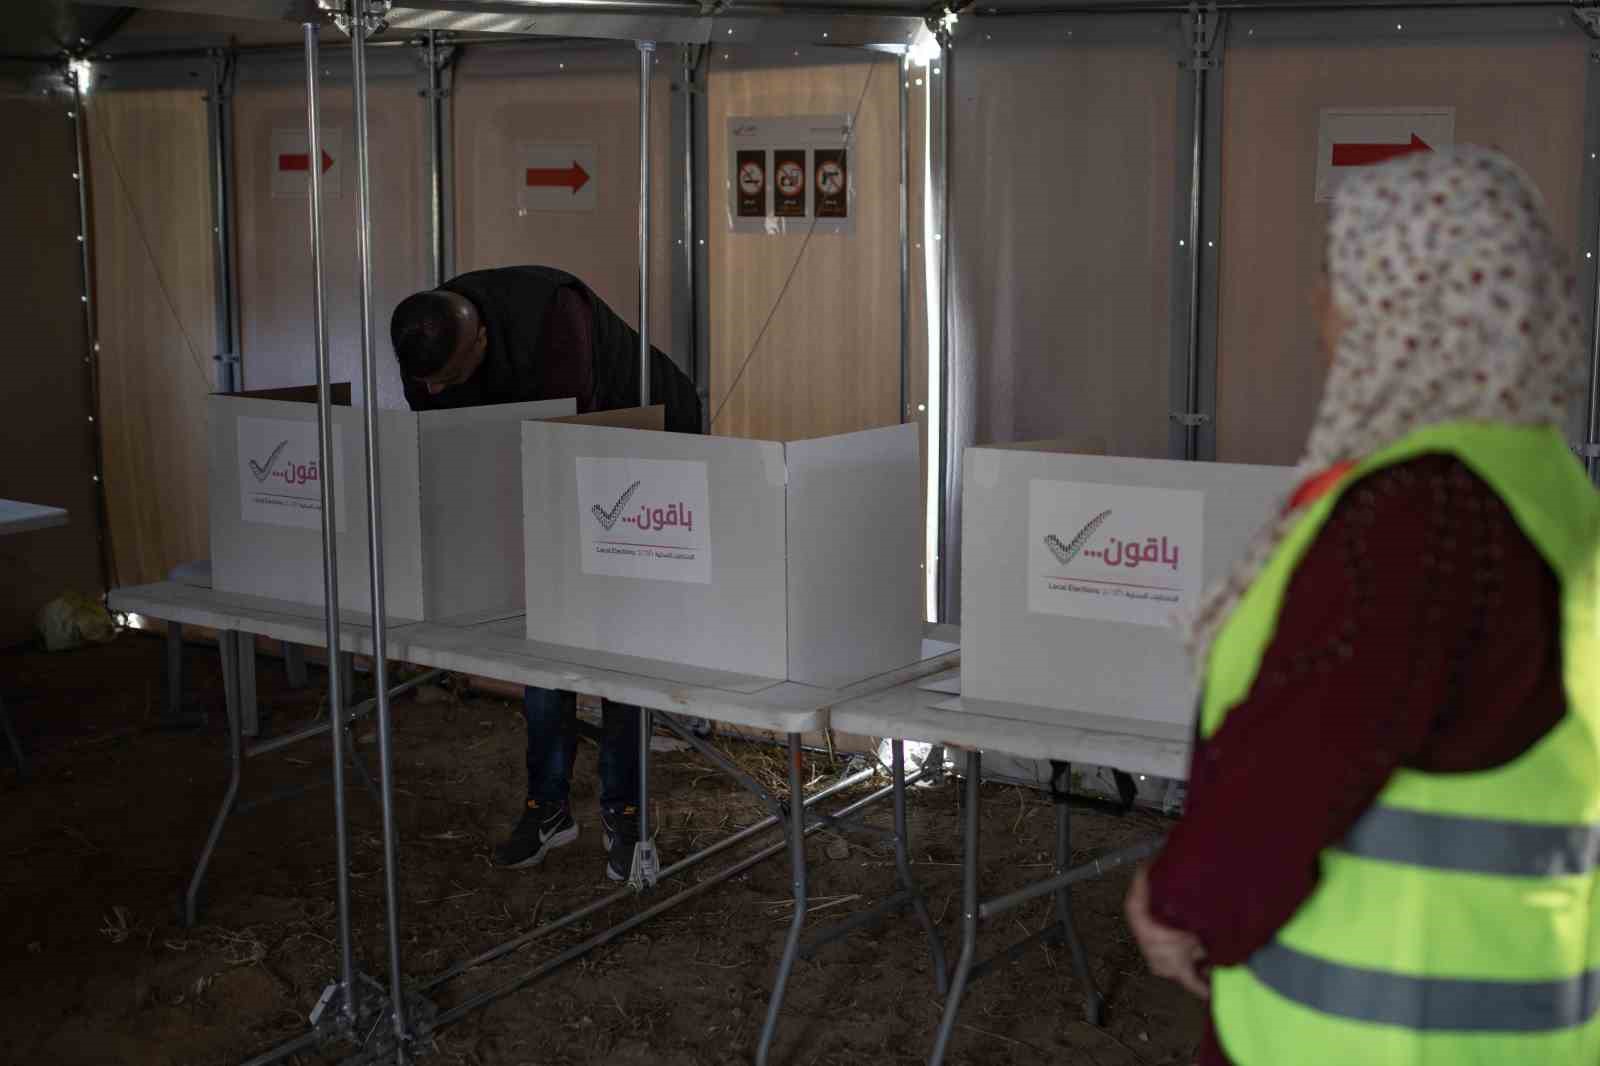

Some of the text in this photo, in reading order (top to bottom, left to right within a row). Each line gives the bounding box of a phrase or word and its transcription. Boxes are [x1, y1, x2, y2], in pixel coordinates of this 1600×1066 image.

[1083, 535, 1180, 571] باقون...
[1048, 583, 1067, 592] Local
[1068, 584, 1100, 595] Elections
